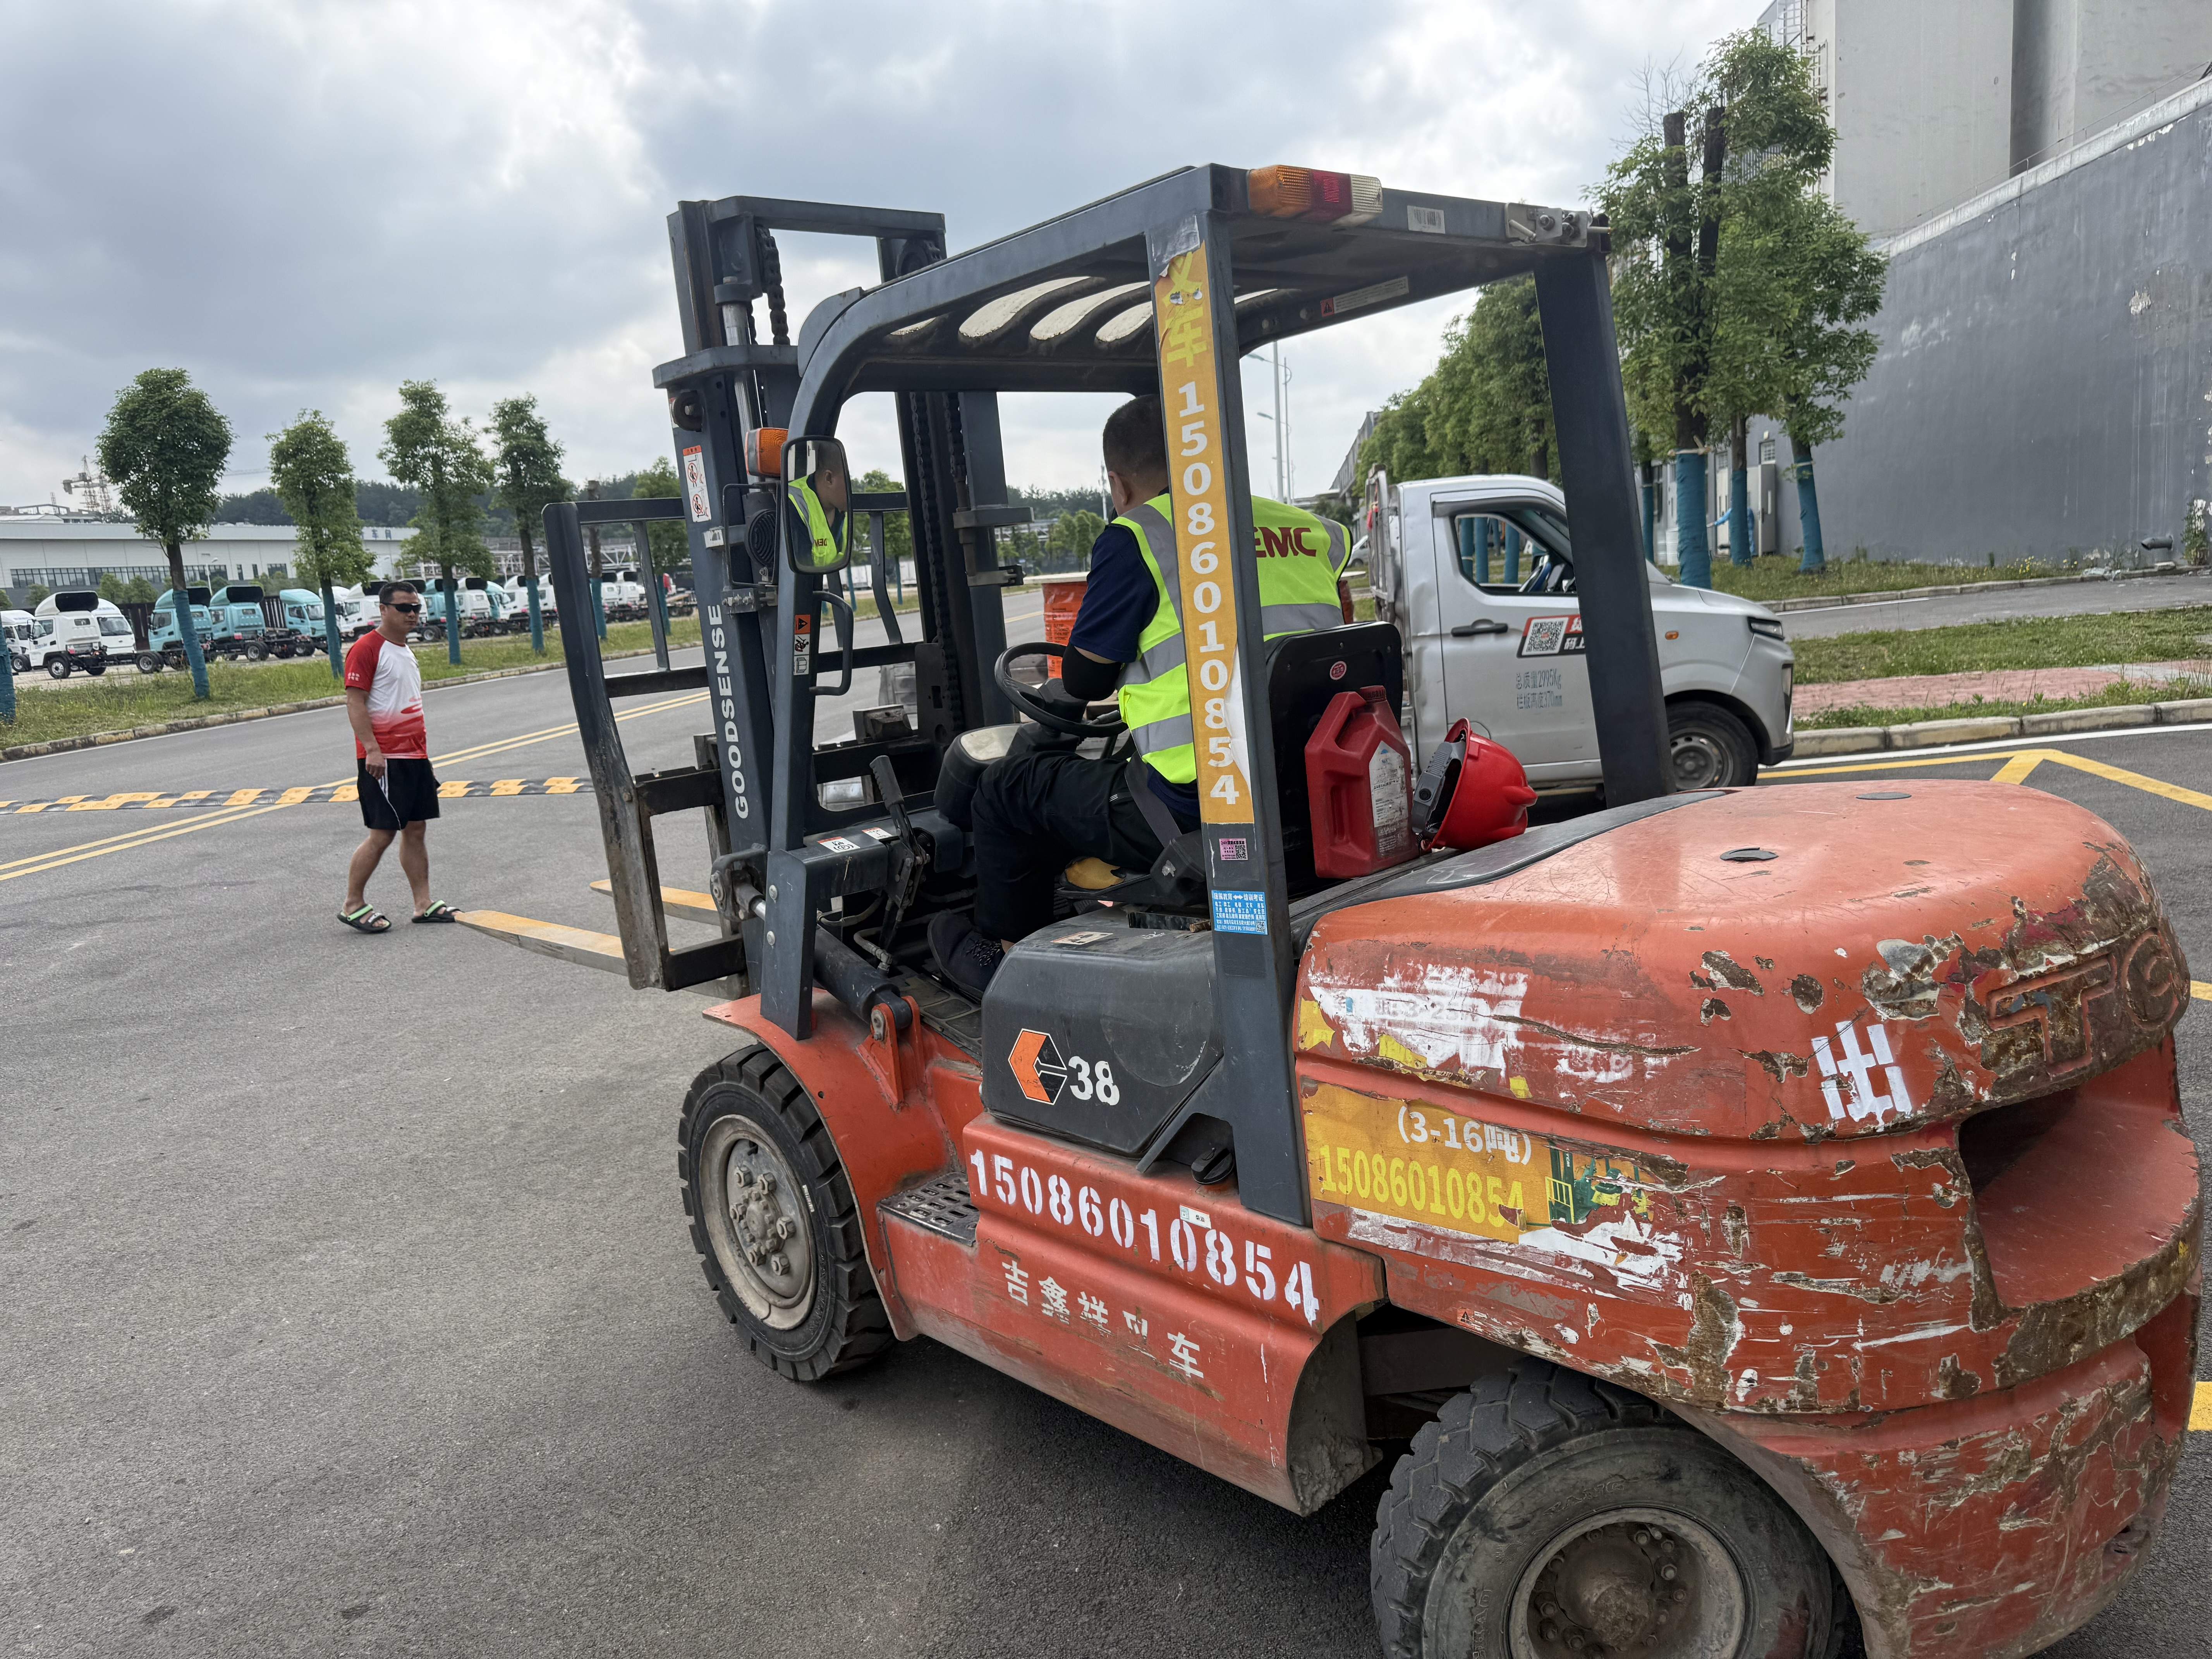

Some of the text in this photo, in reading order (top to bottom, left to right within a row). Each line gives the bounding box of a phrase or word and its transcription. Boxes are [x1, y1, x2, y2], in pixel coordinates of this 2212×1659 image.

[1178, 381, 1239, 805] 15086010854
[708, 604, 749, 819] GOODSENSE
[1067, 1056, 1120, 1106] 38
[1398, 1106, 1532, 1165] (3-16吨)
[970, 1149, 1319, 1326] 15086010854
[1320, 1145, 1524, 1228] 15086010854
